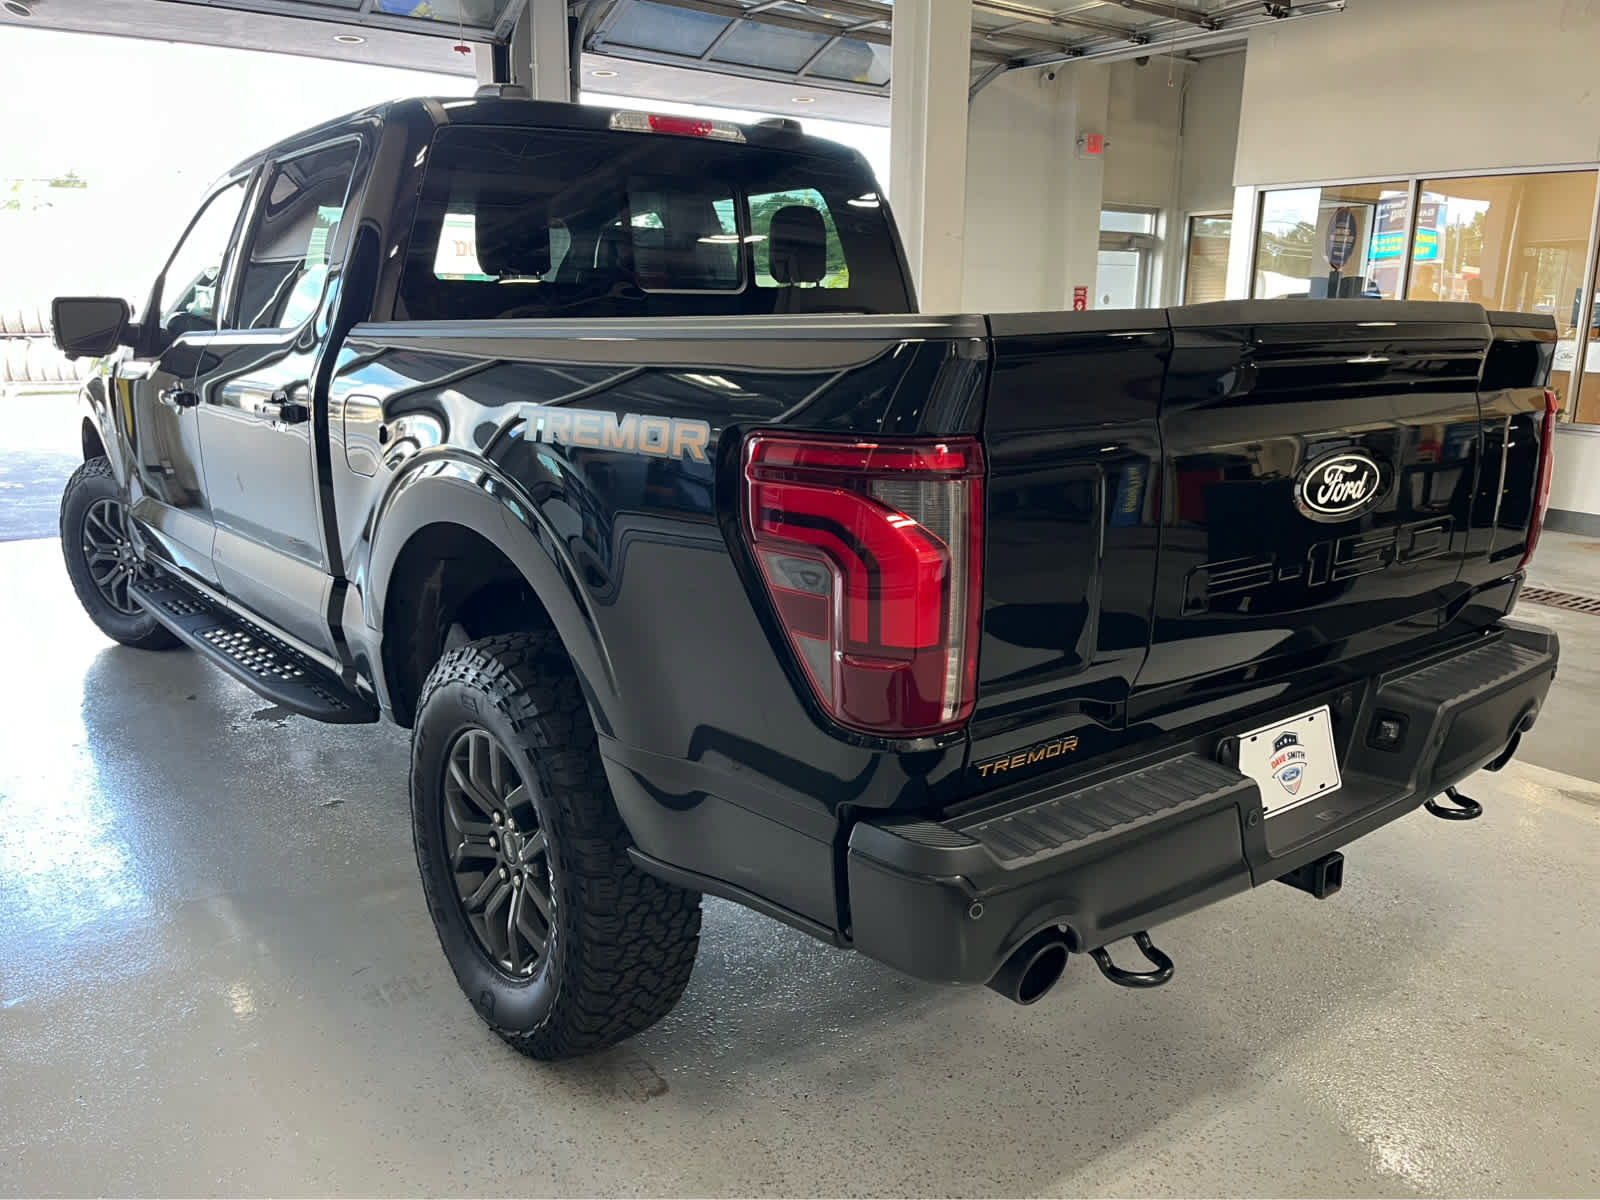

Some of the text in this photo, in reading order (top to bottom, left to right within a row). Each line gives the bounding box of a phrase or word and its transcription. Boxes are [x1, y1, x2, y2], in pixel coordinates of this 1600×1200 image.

[519, 406, 711, 464] TREMOR
[1317, 464, 1368, 504] Ford
[1181, 515, 1456, 616] F-150
[978, 736, 1079, 777] TREMOR
[1271, 751, 1305, 769] DAVE SMITH
